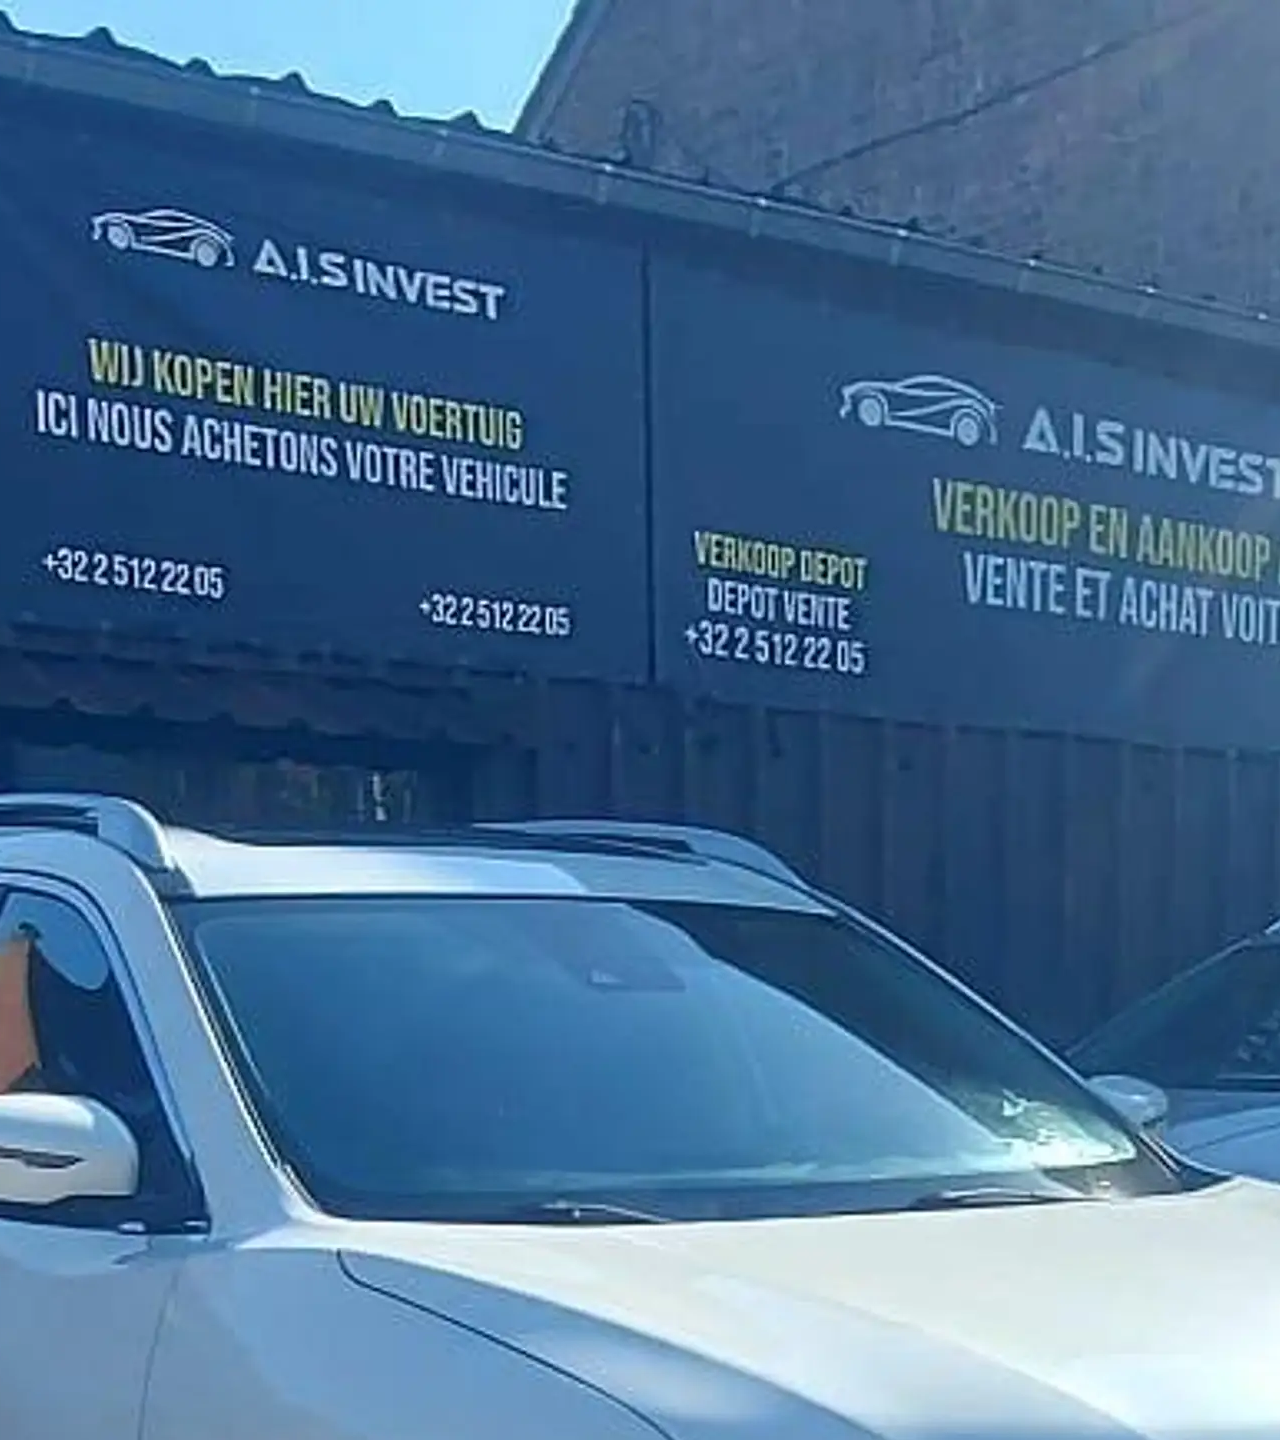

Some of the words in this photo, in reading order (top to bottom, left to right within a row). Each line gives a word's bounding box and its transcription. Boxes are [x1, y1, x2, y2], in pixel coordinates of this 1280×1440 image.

[351, 257, 507, 320] INVEST
[87, 336, 145, 389] WIJ
[152, 349, 256, 408] KOPEN
[262, 366, 333, 420] HIER
[337, 379, 386, 429] UW
[390, 390, 524, 451] VOERTUIG
[35, 387, 79, 440] ICI
[86, 397, 175, 454] NOUS
[179, 413, 339, 478] ACHETONS
[342, 438, 436, 493] VOTRE
[439, 452, 570, 511] VEHICULE
[693, 530, 797, 580] VERKOOP
[799, 550, 868, 591] DEPOT
[932, 476, 1082, 549] VERKOOP
[1089, 503, 1129, 560] EN
[1135, 512, 1271, 584] AANKOOP
[41, 547, 89, 583] +32
[93, 553, 109, 586] 2
[112, 553, 158, 591] 512
[160, 560, 192, 596] 22
[193, 565, 225, 600] 05
[706, 576, 779, 622] DEPOT
[781, 588, 855, 632] VENTE
[962, 550, 1068, 616] VENTE
[1075, 566, 1112, 622] ET
[1118, 575, 1215, 637] ACHAT
[419, 593, 458, 626] +32
[460, 596, 474, 627] 2
[476, 599, 514, 632] 512
[517, 603, 542, 635] 22
[544, 605, 571, 636] 05
[684, 618, 729, 657] +32
[732, 625, 751, 660] 2
[753, 629, 798, 667] 512
[801, 635, 834, 670] 22
[835, 639, 867, 675] 05
